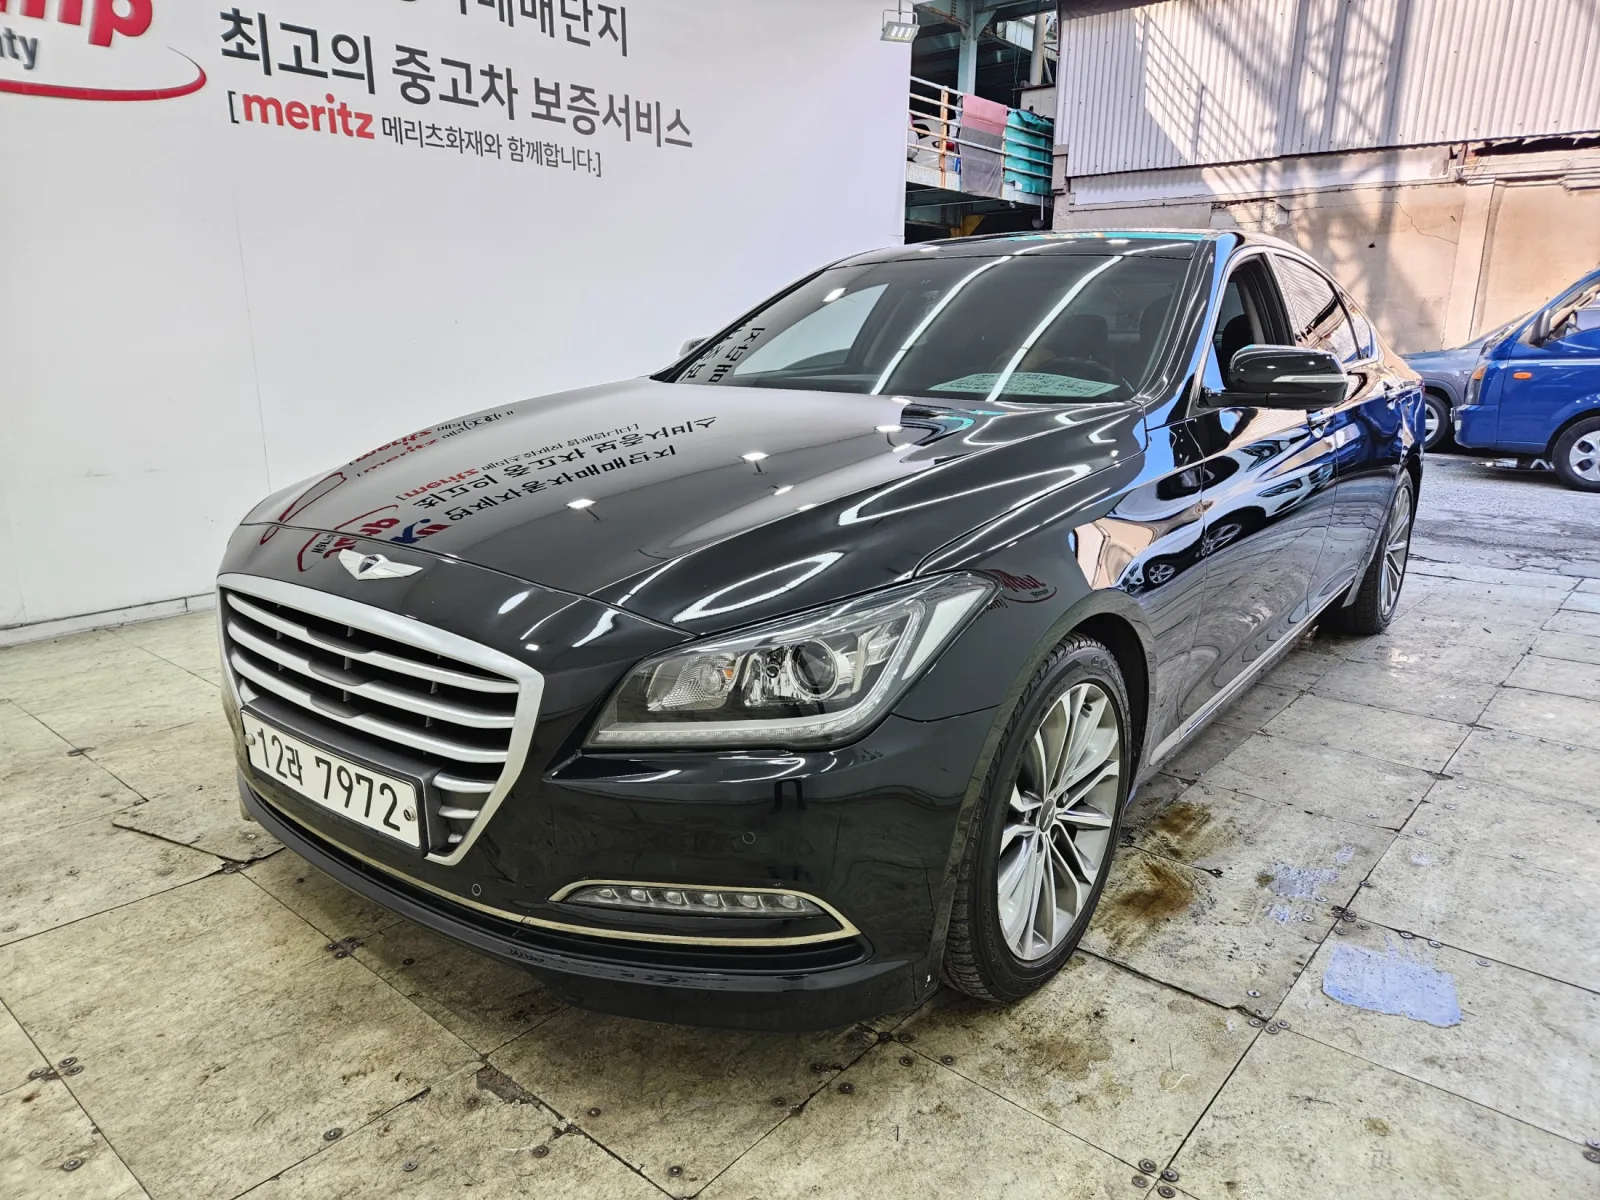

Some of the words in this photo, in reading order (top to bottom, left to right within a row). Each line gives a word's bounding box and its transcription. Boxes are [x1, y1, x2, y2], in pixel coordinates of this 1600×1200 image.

[0, 26, 38, 70] ty
[219, 7, 376, 96] 최고의
[391, 43, 519, 121] 중고차
[530, 77, 693, 149] 보증서비스
[381, 116, 503, 160] 메리츠화재와
[256, 726, 304, 786] 12라
[314, 755, 401, 832] 7972
